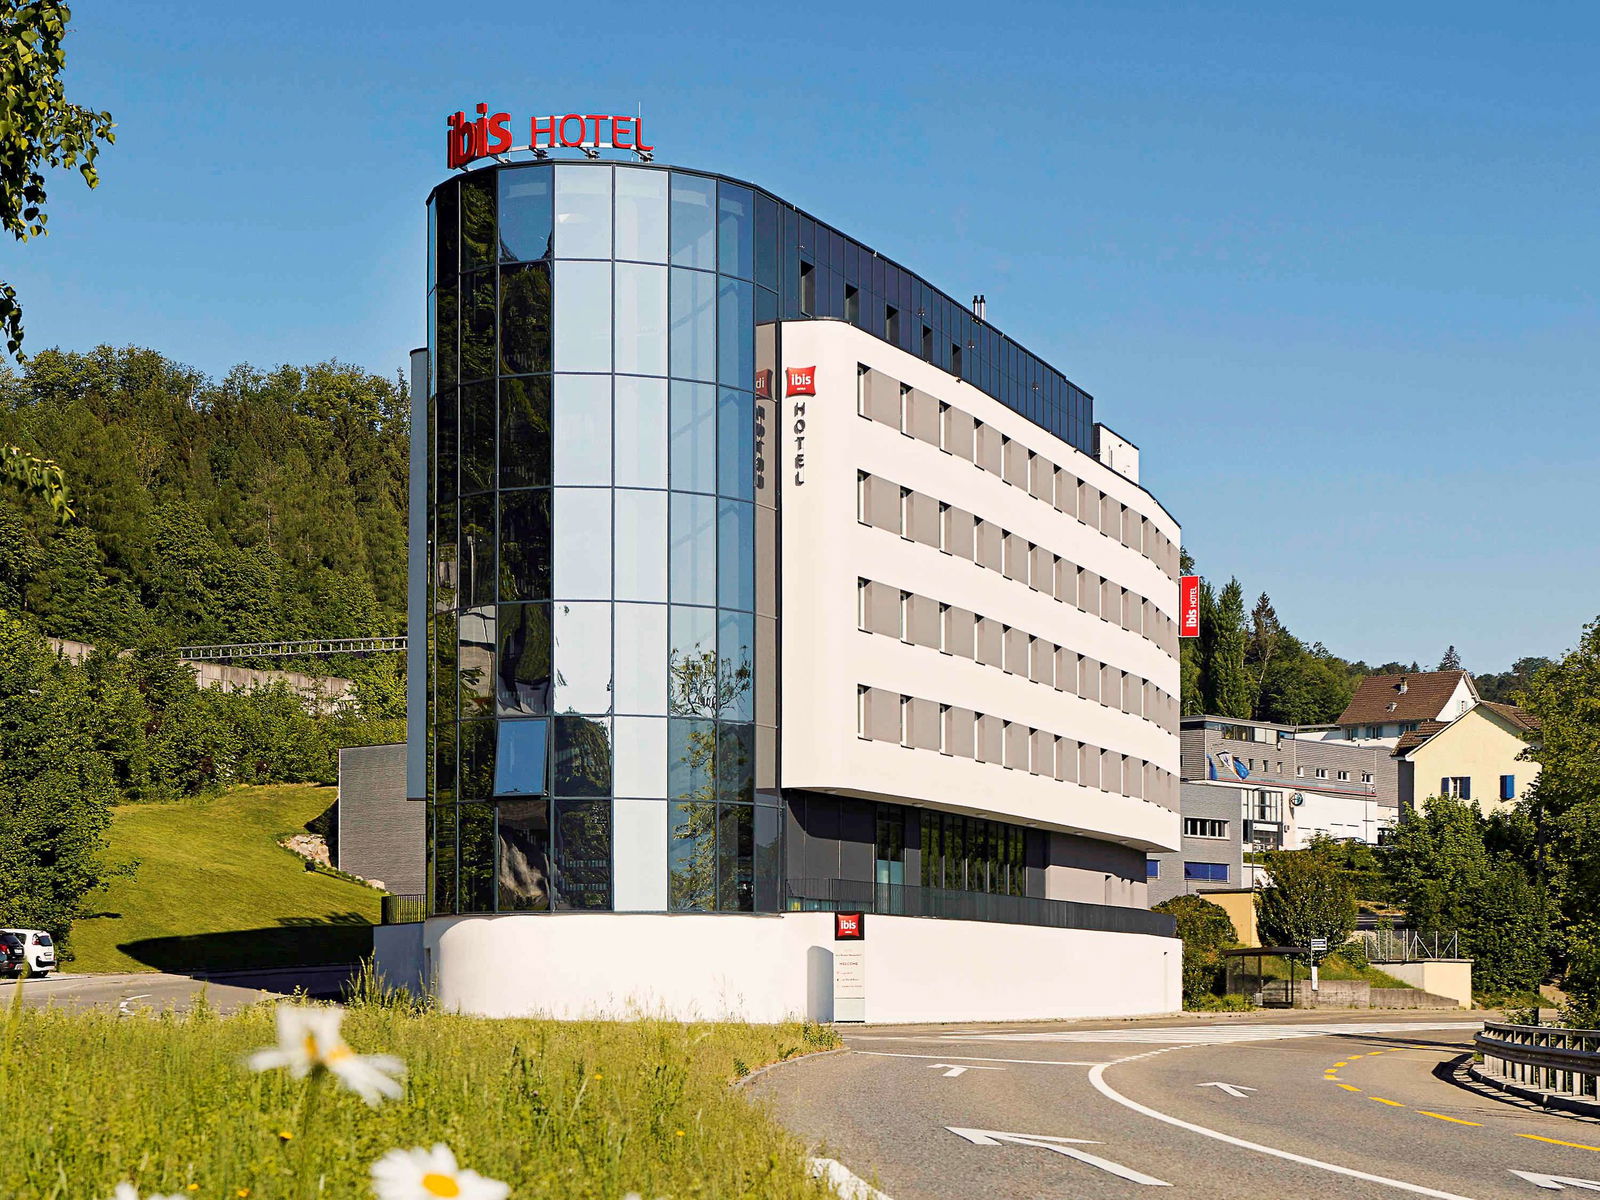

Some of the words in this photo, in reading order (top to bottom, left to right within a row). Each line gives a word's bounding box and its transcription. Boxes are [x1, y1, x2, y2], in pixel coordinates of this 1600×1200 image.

[447, 103, 513, 169] ibis
[530, 113, 655, 151] HOTEL
[791, 373, 811, 386] ibis
[794, 402, 806, 486] HOTEL
[1189, 586, 1197, 608] HOTEL
[1185, 609, 1197, 627] ibis
[840, 920, 856, 930] ibis
